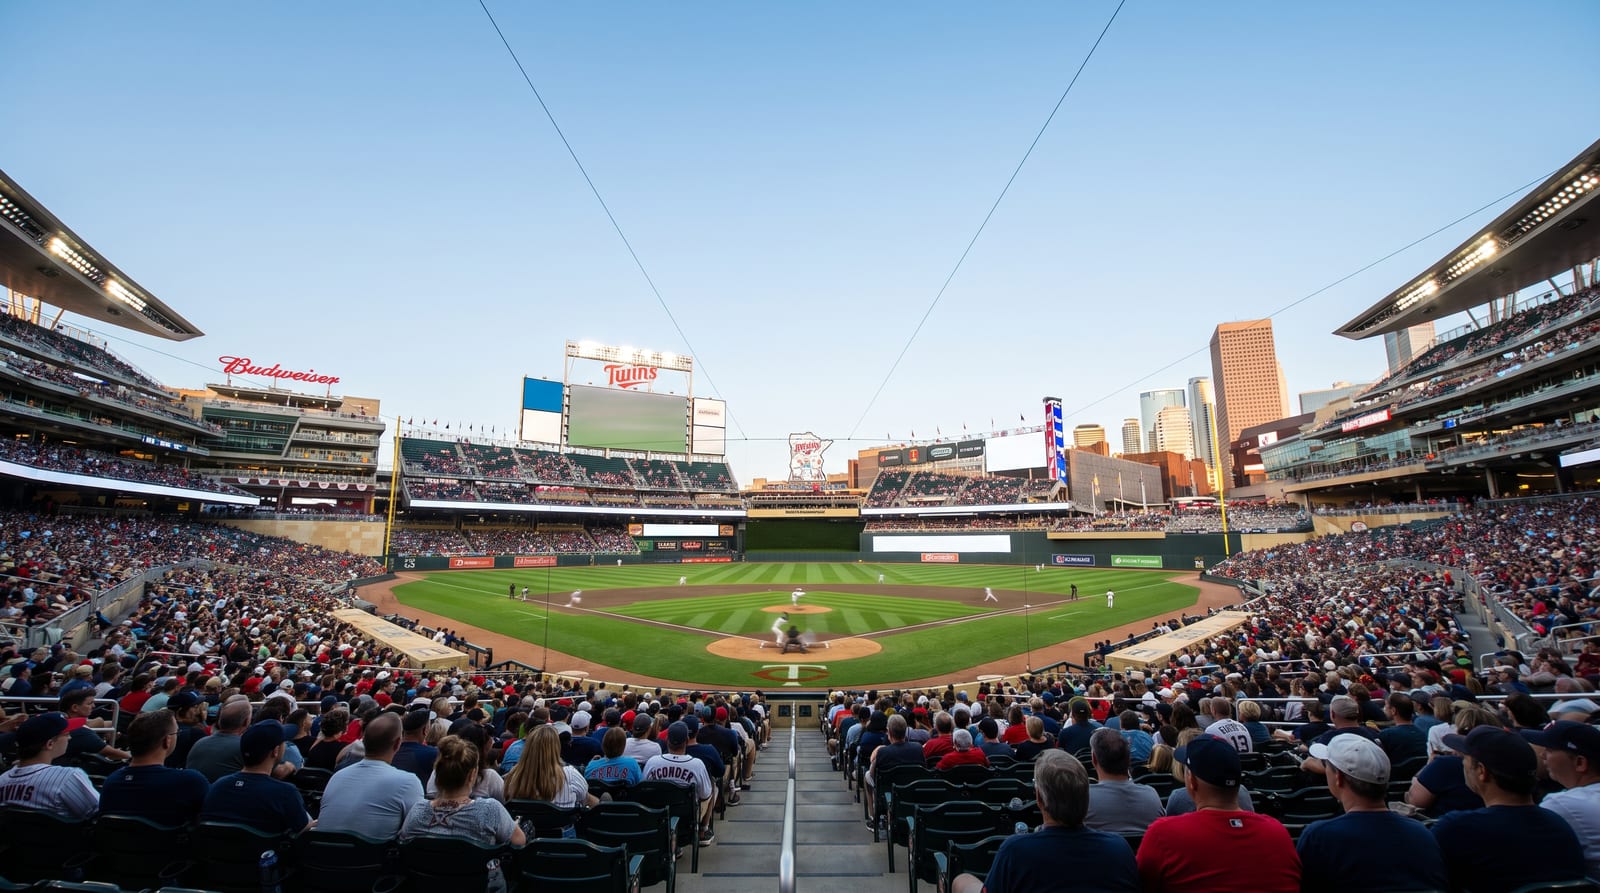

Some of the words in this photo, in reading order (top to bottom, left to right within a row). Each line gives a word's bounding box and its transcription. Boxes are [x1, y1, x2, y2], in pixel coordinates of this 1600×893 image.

[219, 355, 340, 384] Budweiser
[603, 364, 658, 386] Twins
[1231, 735, 1249, 752] 13
